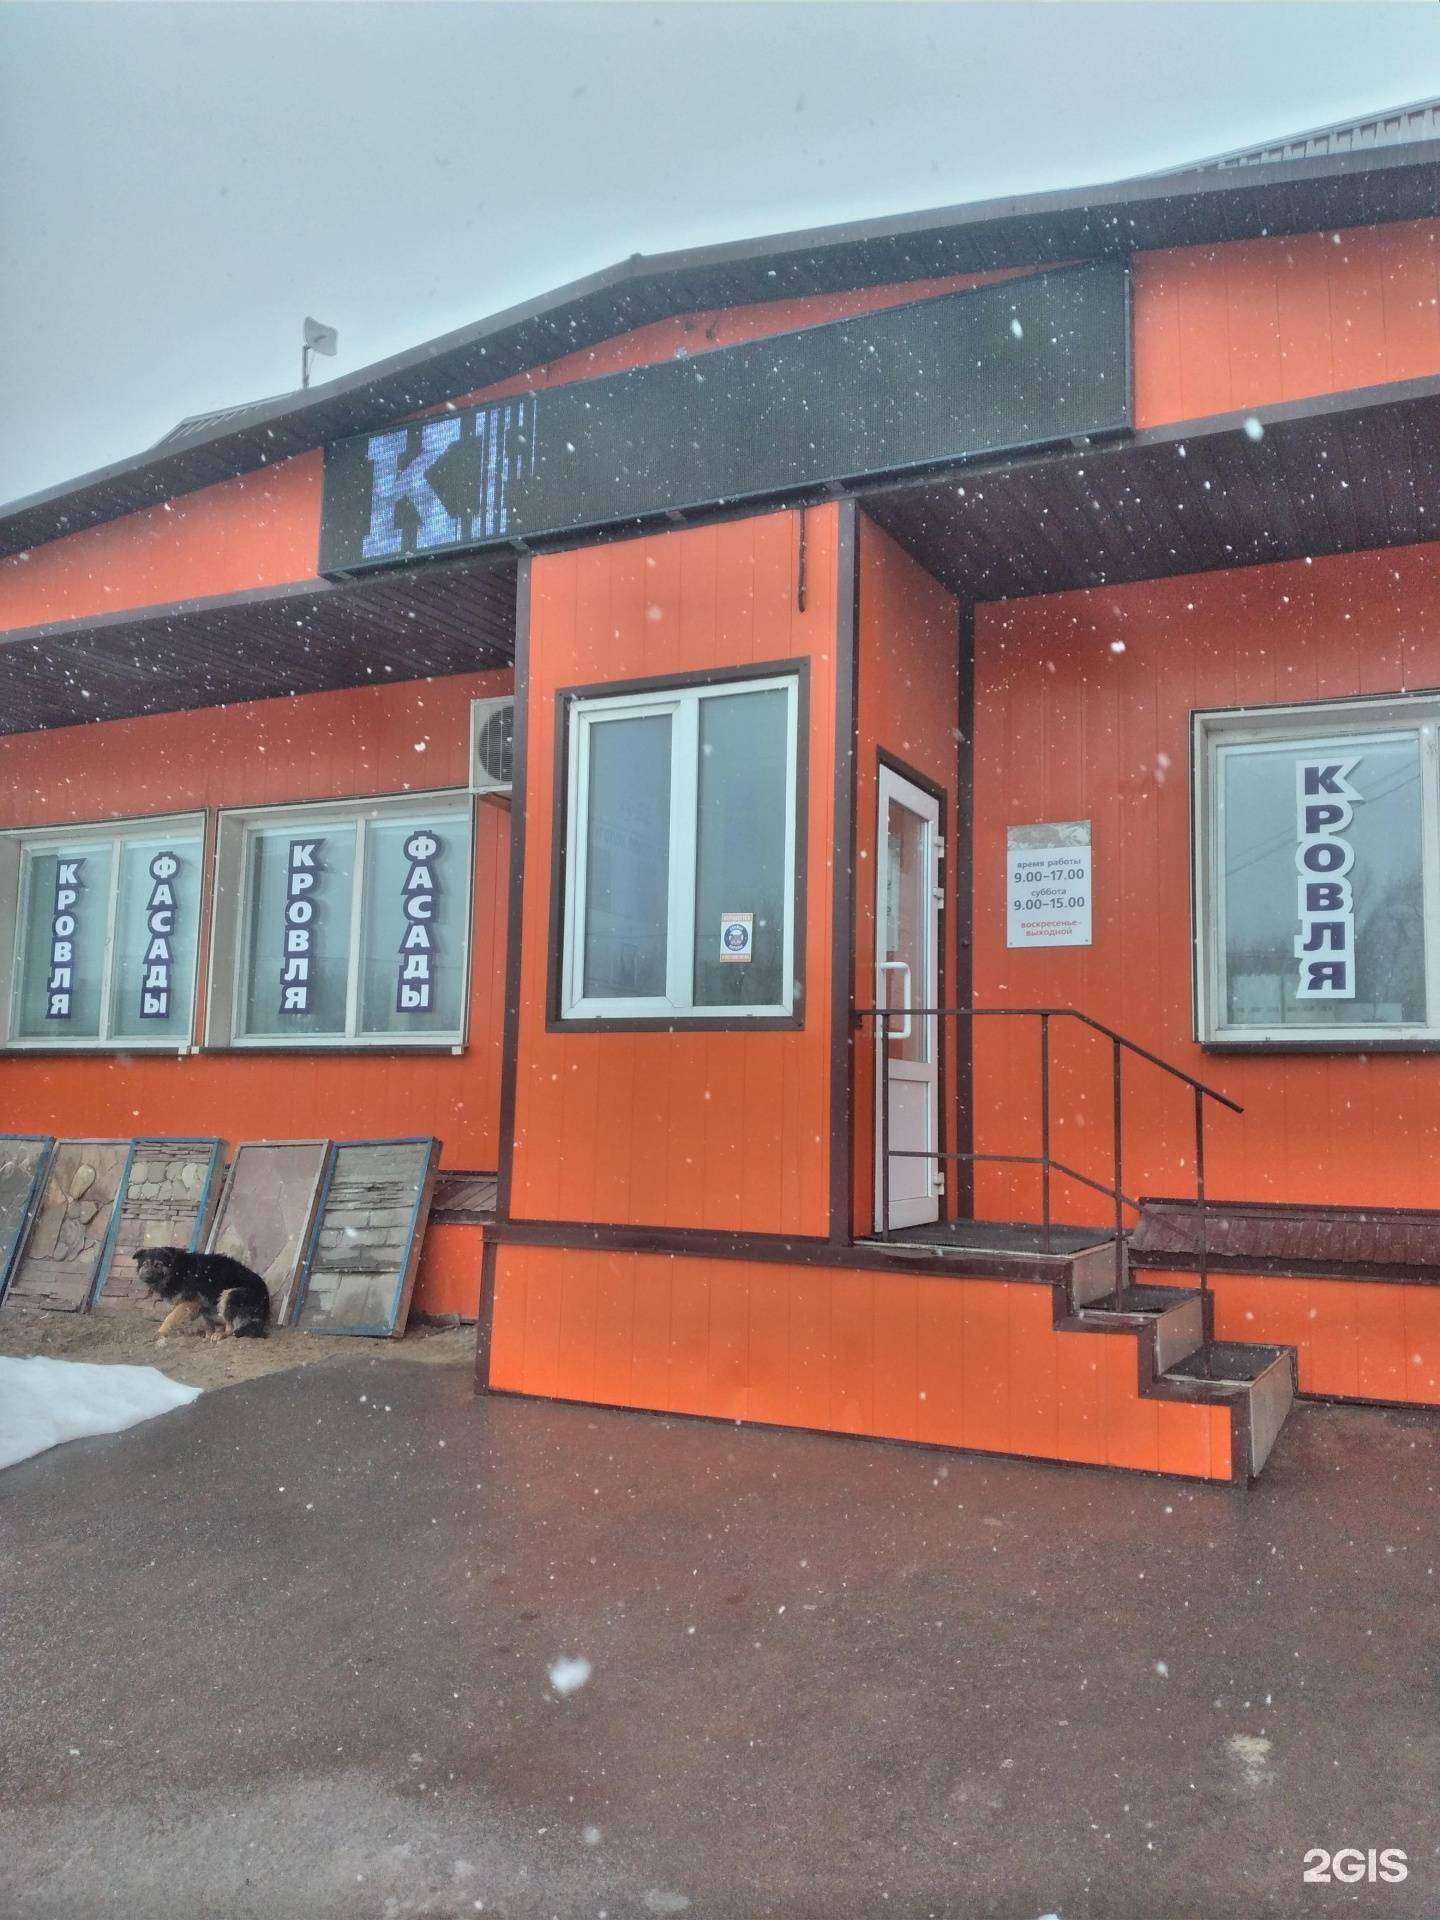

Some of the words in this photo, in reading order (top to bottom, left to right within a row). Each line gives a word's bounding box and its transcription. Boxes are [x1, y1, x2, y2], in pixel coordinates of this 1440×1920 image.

[49, 862, 78, 1015] КРОВЛЯ
[143, 855, 178, 1014] ФАСАДЫ
[283, 844, 315, 1010] КРОВЛЯ
[400, 835, 438, 1008] ФАСАДЫ
[1017, 860, 1045, 869] время
[1047, 857, 1081, 868] работы
[1025, 928, 1072, 937] выходной
[1031, 887, 1067, 898] суббота
[1303, 764, 1347, 991] КРОВЛЯ
